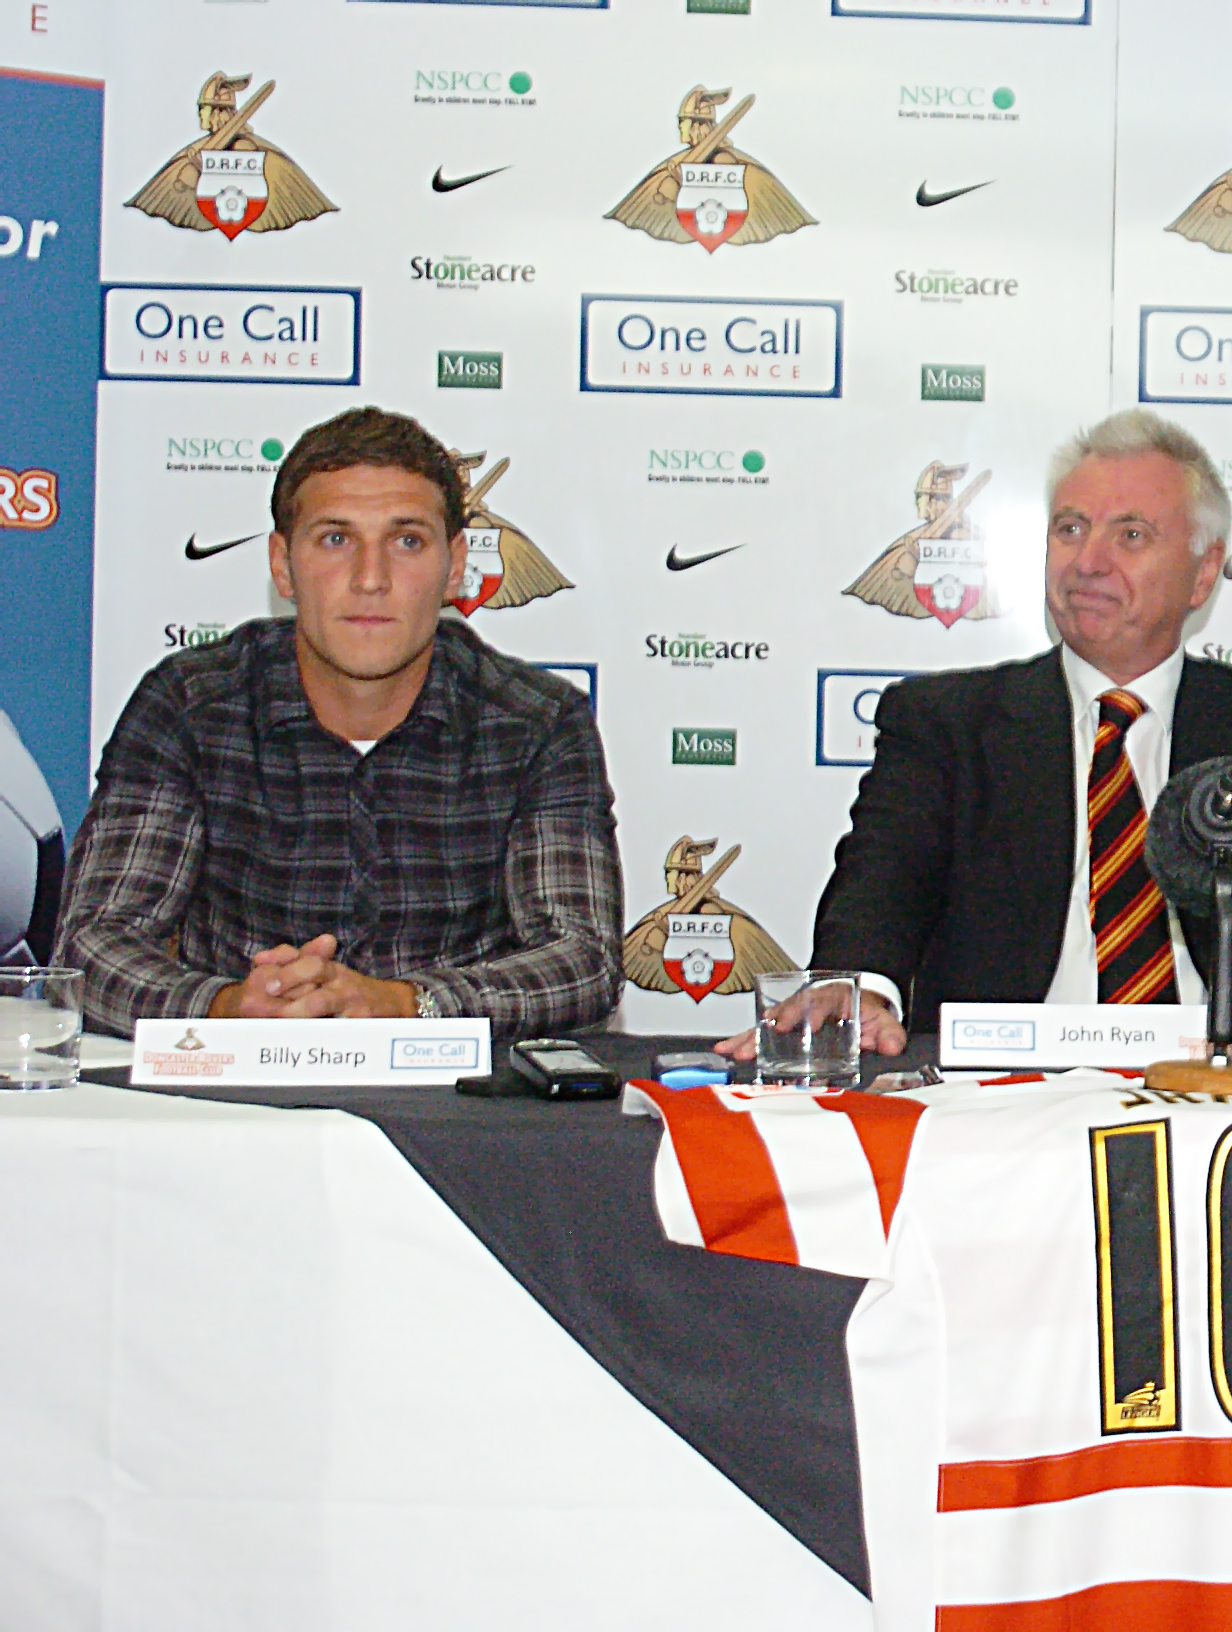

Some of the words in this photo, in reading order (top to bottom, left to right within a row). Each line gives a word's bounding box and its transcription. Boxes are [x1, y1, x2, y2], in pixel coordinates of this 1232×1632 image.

[414, 70, 502, 92] NSPCC
[899, 85, 986, 107] NSPCC
[205, 157, 262, 170] D.R.F.C.
[685, 170, 742, 184] D.R.F.C.
[410, 255, 536, 282] Stoneacre
[894, 269, 1019, 296] Stoneacre
[135, 302, 225, 341] One
[242, 304, 319, 343] Call
[617, 314, 707, 353] One
[724, 316, 801, 355] Call
[139, 350, 319, 367] INSURANCE
[442, 355, 499, 376] Moss
[621, 361, 800, 380] INSURANCE
[926, 368, 982, 389] Moss
[166, 437, 254, 459] NSPCC
[648, 449, 735, 471] NSPCC
[645, 633, 770, 660] Stoneacre
[677, 732, 733, 753] Moss
[671, 921, 728, 935] D.R.F.C.
[963, 1024, 993, 1038] One
[997, 1025, 1023, 1039] Call
[1059, 1025, 1104, 1043] John
[1110, 1026, 1156, 1045] Ryan
[259, 1046, 302, 1068] Billy
[307, 1047, 366, 1069] Sharp
[403, 1043, 434, 1057] One
[438, 1043, 466, 1057] Call
